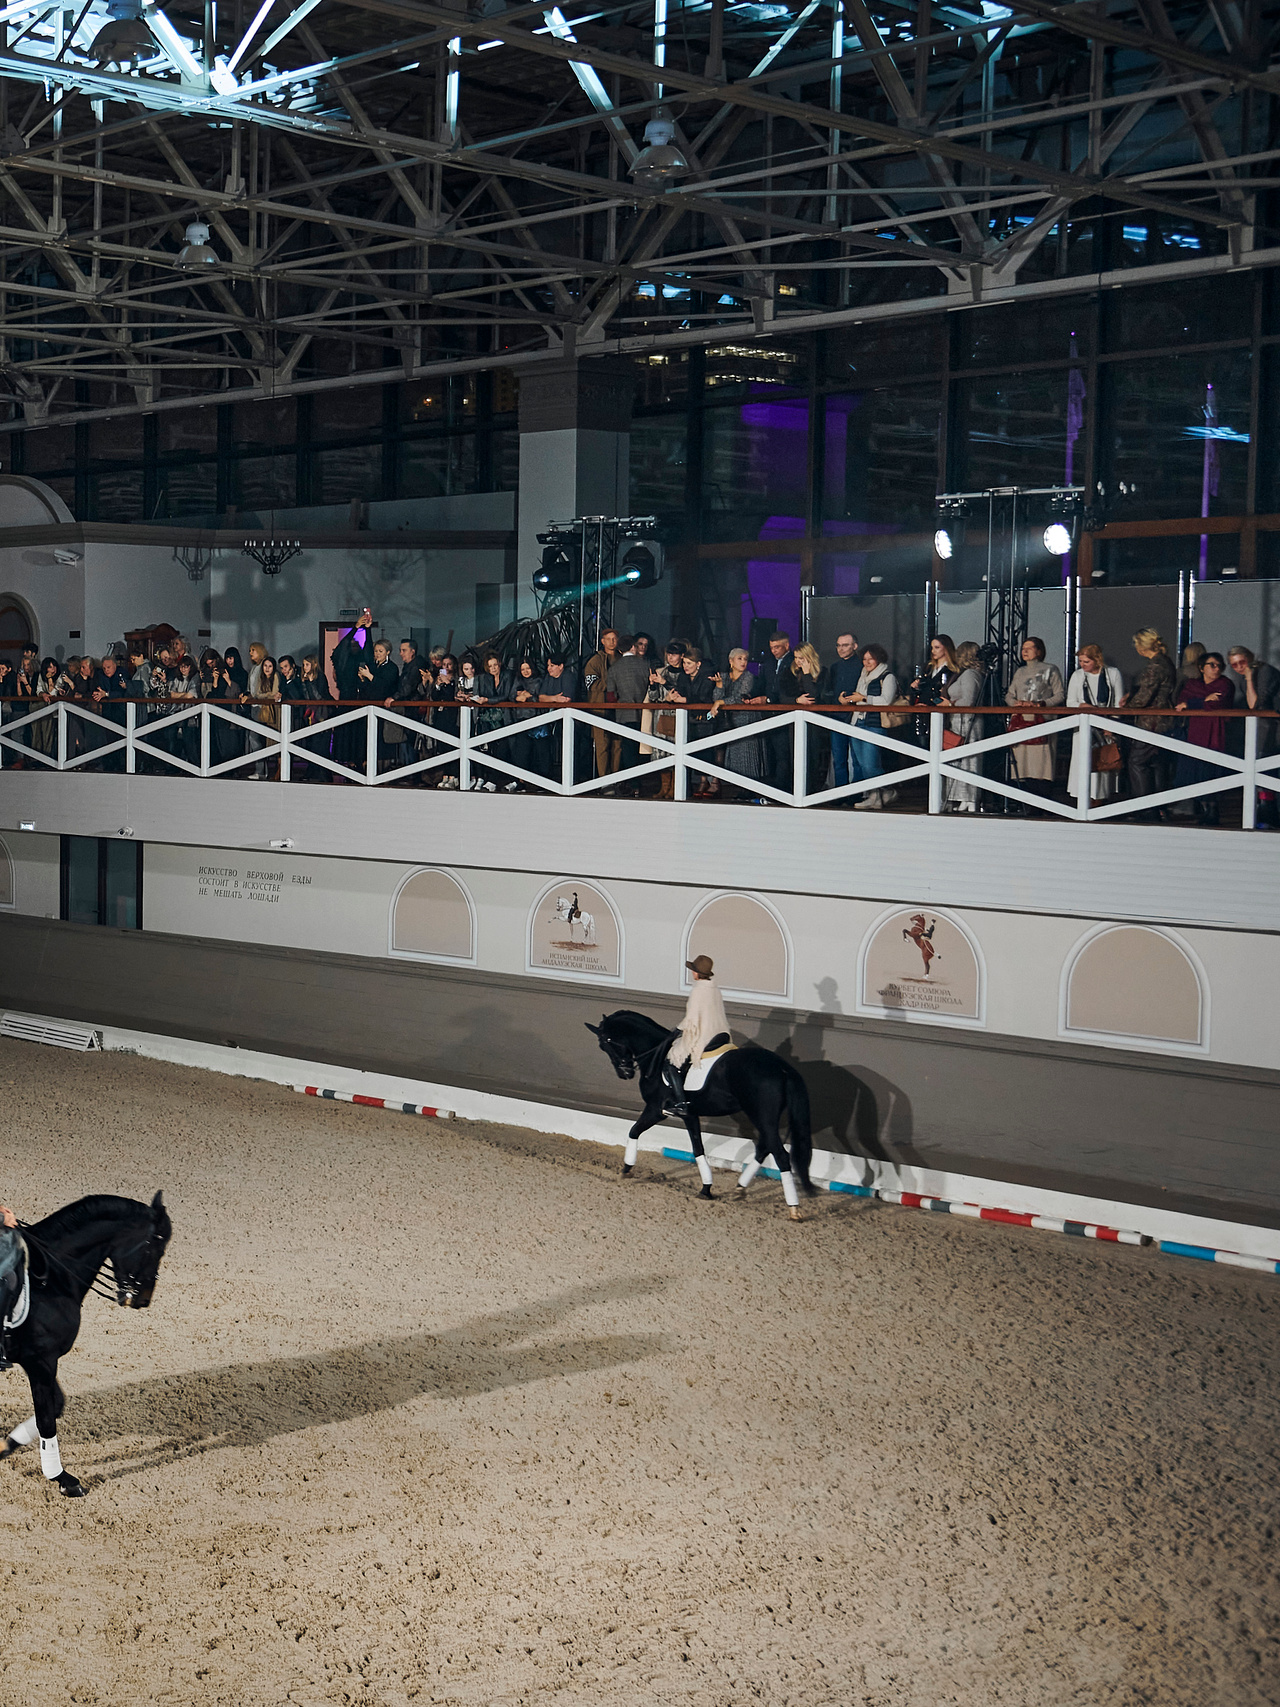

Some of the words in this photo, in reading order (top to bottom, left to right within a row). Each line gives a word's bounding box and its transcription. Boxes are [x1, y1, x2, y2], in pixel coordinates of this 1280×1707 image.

[198, 866, 237, 877] ИСКУССТВО
[246, 870, 284, 882] ВЕРХОВОЙ
[291, 874, 312, 885] ЕЗДЫ
[198, 876, 229, 887] СОСТОИТ
[234, 880, 239, 888] В
[242, 880, 282, 892] ИСКУССТВЕ
[198, 887, 208, 896] НЕ
[213, 888, 243, 899] МЕШАТЬ
[247, 891, 280, 903] ЛОШАДИ
[542, 958, 583, 969] АНДАЛУЗСКАЯ
[549, 953, 585, 962] ИСПАНСКИЙ
[889, 983, 915, 992] КУРБЕТ
[917, 986, 951, 996] СОМЮРА
[878, 990, 932, 1000] ФРАНЦУЗСКАЯ
[934, 997, 962, 1005] ШКОЛА
[899, 999, 920, 1008] КАДР
